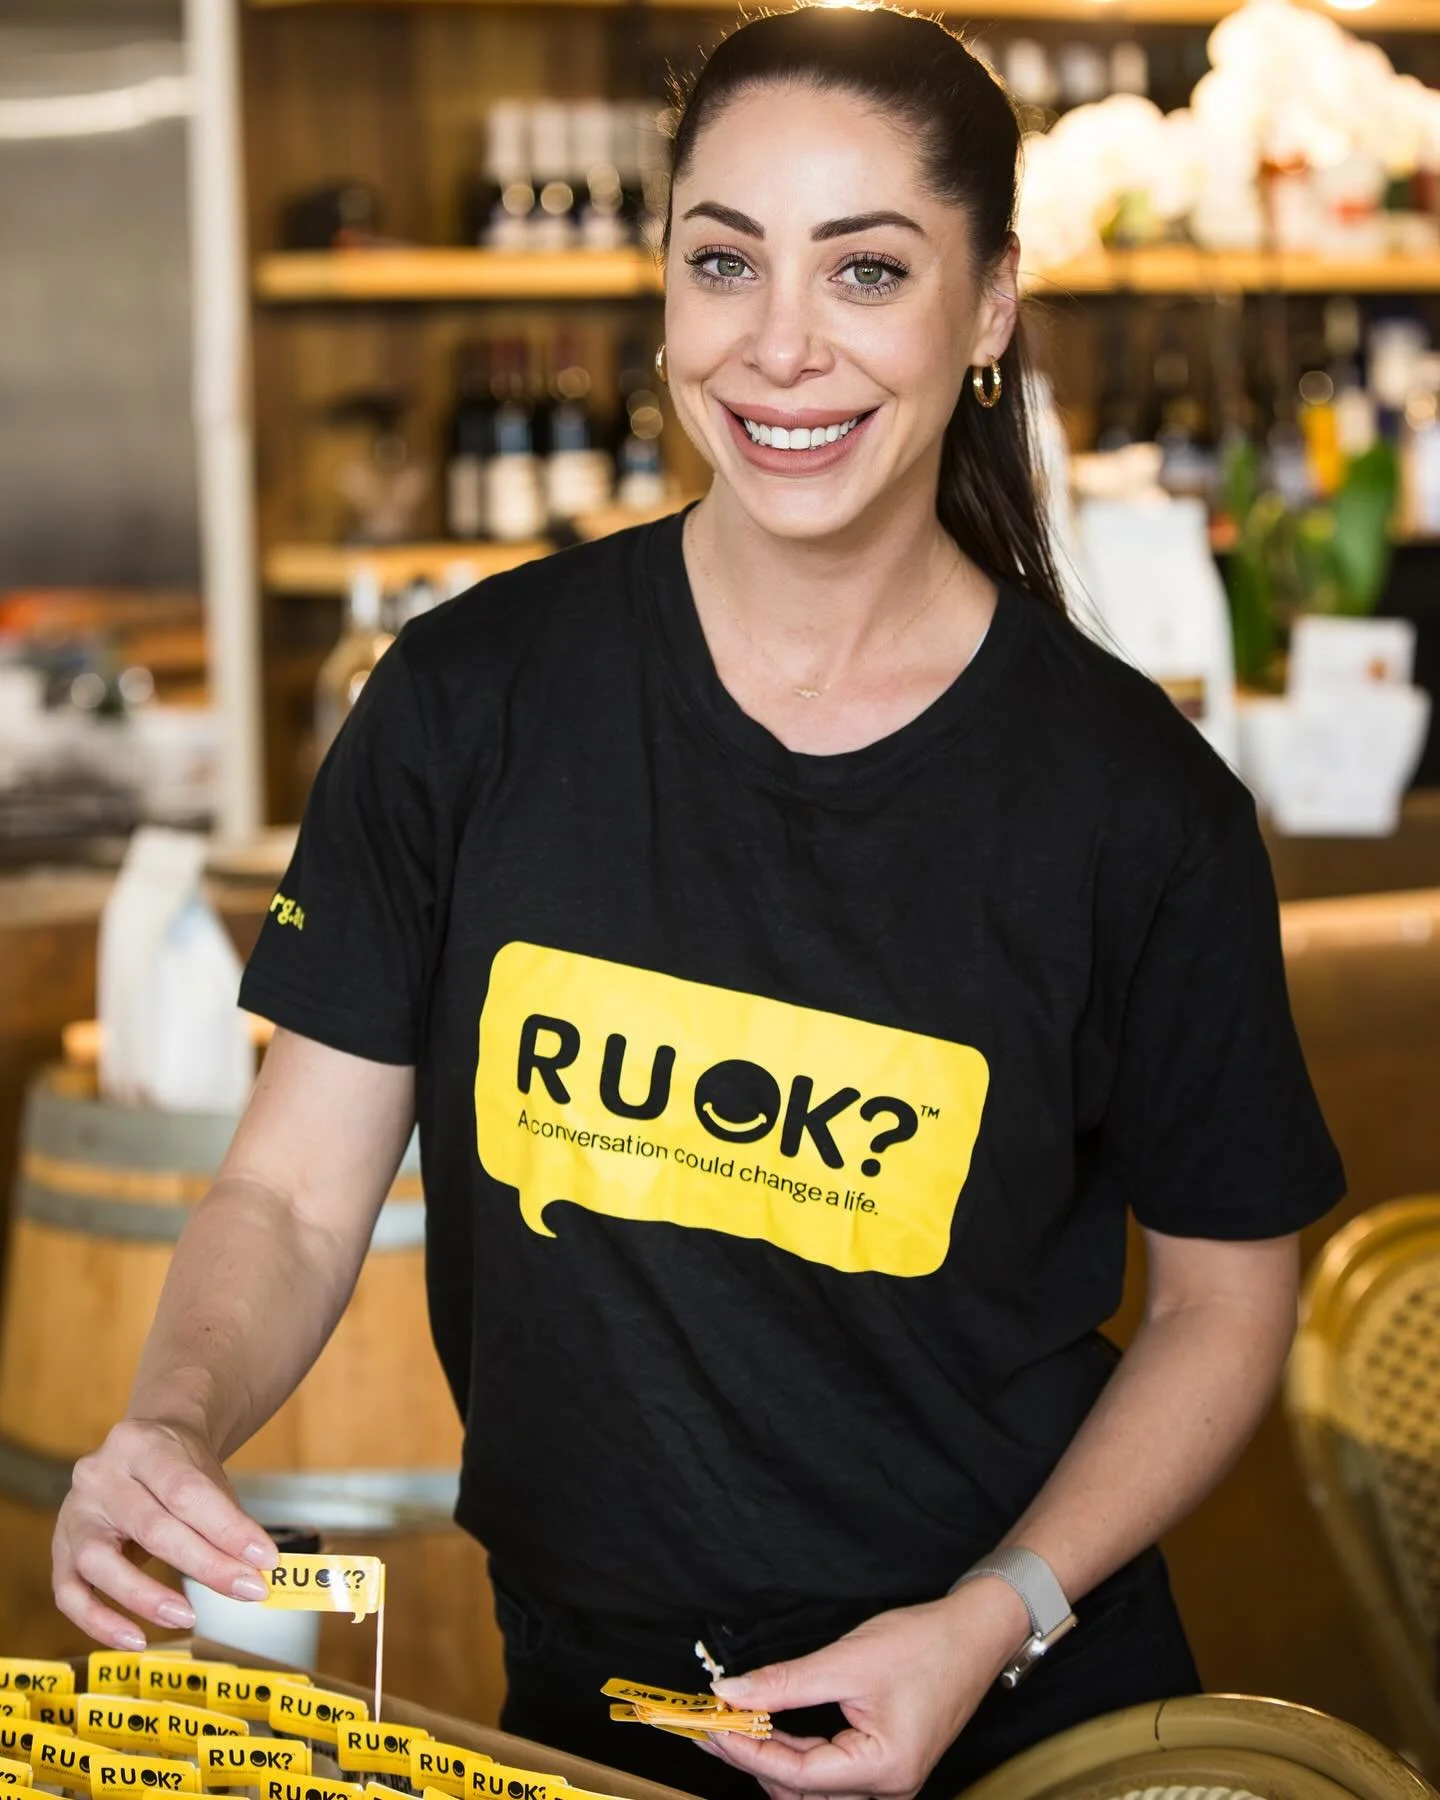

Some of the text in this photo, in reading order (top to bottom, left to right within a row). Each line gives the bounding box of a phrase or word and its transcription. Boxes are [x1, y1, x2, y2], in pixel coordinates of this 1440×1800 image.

[518, 1109, 879, 1216] A conversation could change a life.
